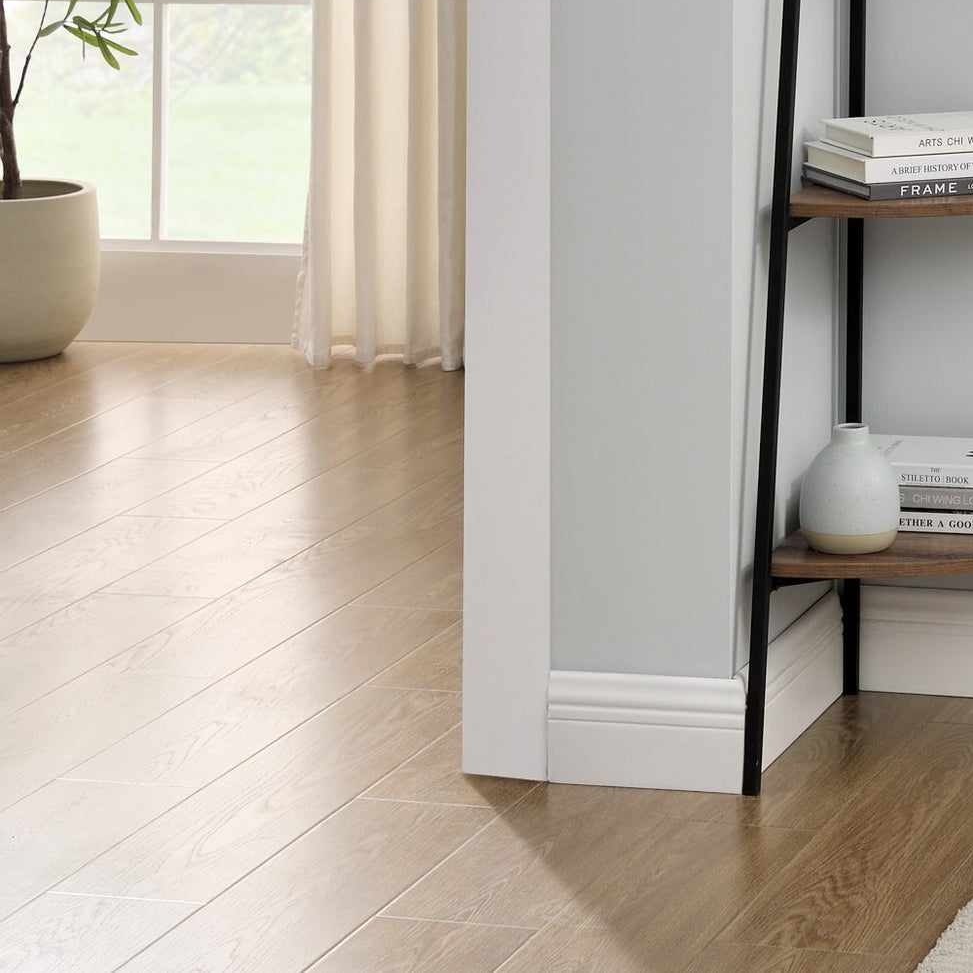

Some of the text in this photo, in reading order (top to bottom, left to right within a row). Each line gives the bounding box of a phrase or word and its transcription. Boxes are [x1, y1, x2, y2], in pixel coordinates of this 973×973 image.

[918, 138, 943, 148] ARTS
[947, 137, 963, 146] CHI
[891, 167, 898, 175] A
[899, 165, 922, 175] BRIEF
[923, 163, 960, 173] HISTORY
[960, 163, 972, 171] OF
[900, 182, 958, 197] FRAME
[901, 473, 969, 484] STILETTO BOOK
[912, 493, 930, 503] CHI
[932, 494, 961, 505] WING
[937, 519, 944, 528] A
